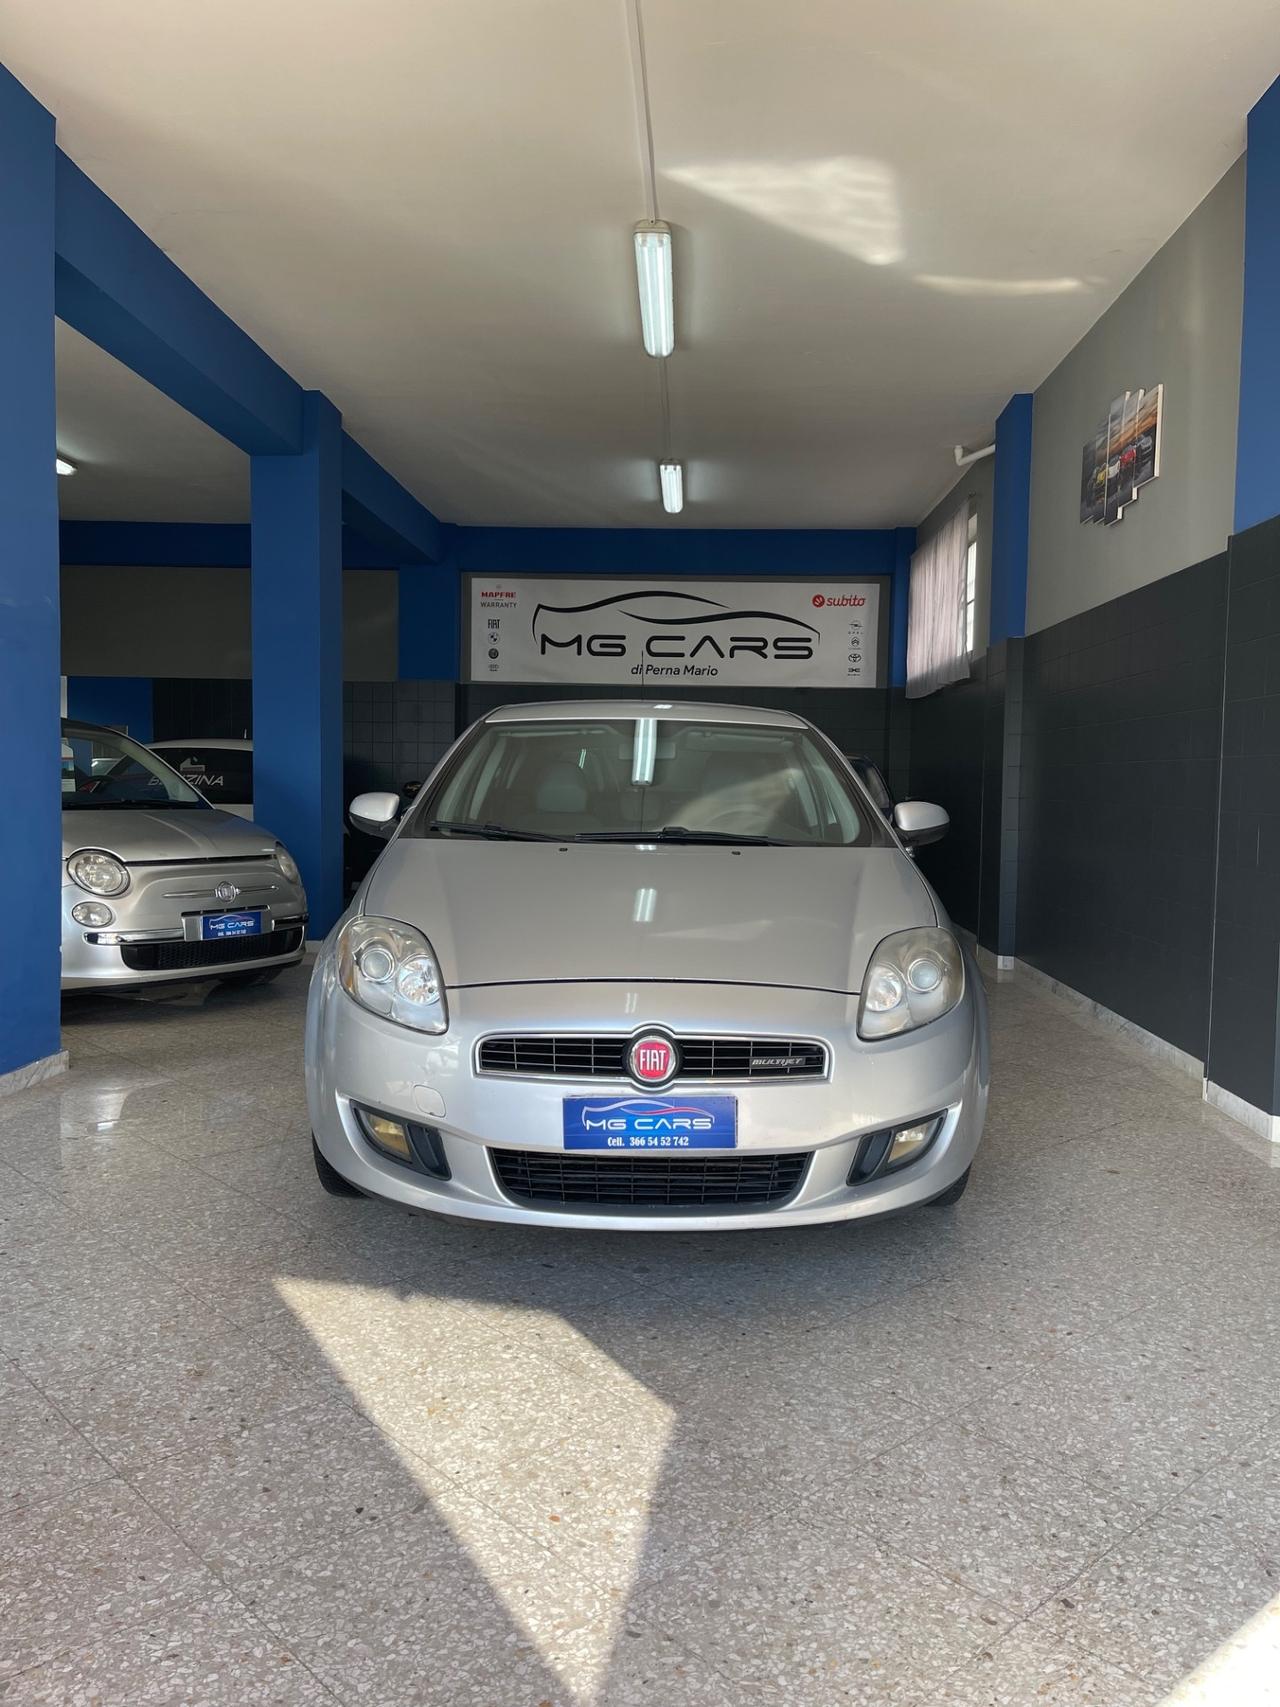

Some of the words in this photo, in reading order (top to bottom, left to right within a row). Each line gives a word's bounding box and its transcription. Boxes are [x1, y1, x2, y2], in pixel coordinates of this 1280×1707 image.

[826, 595, 866, 607] subito
[541, 633, 626, 657] MG
[646, 635, 813, 660] CARS
[631, 664, 643, 675] di
[645, 665, 680, 676] Perna
[683, 665, 718, 676] Mario
[227, 920, 254, 928] CARS
[639, 1049, 667, 1071] FIAT
[751, 1057, 803, 1067] MULTIJET
[586, 1119, 627, 1130] MG
[634, 1119, 712, 1130] CARS
[607, 1136, 625, 1147] Cell.
[629, 1136, 646, 1147] 366
[647, 1136, 659, 1147] 54
[660, 1136, 671, 1147] 52
[673, 1136, 690, 1147] 742
